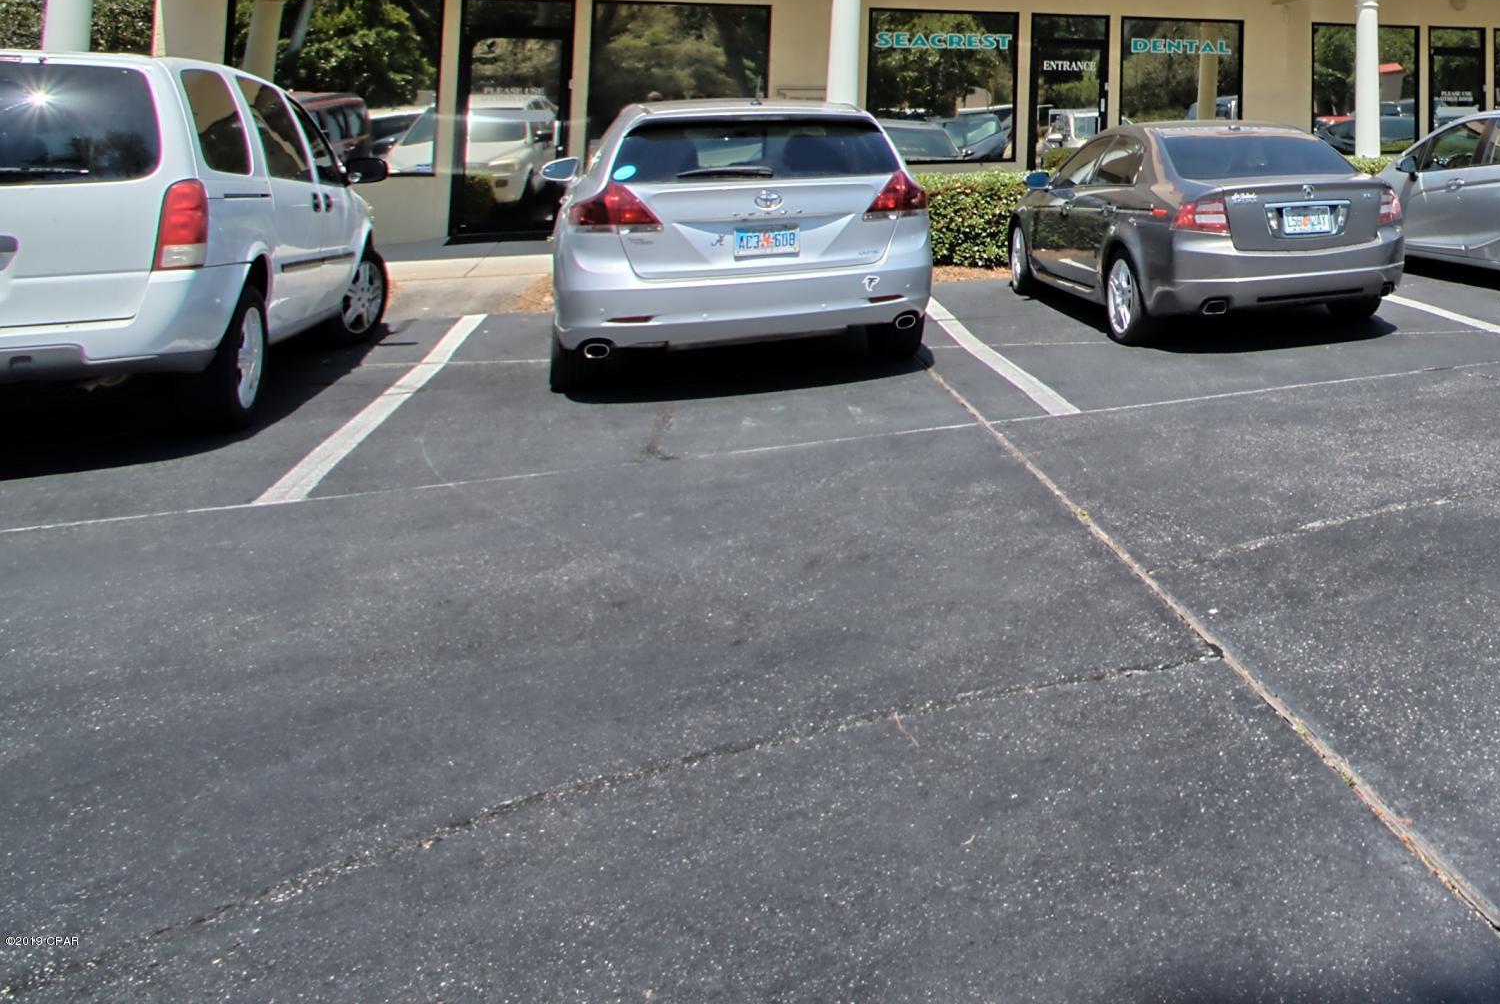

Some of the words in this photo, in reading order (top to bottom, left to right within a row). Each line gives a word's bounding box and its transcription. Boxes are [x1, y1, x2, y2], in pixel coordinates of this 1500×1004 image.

[873, 31, 1013, 51] SEACREST
[1130, 37, 1233, 55] DENTAL
[1043, 60, 1097, 72] ENTRANCE
[483, 87, 522, 95] PLEASE
